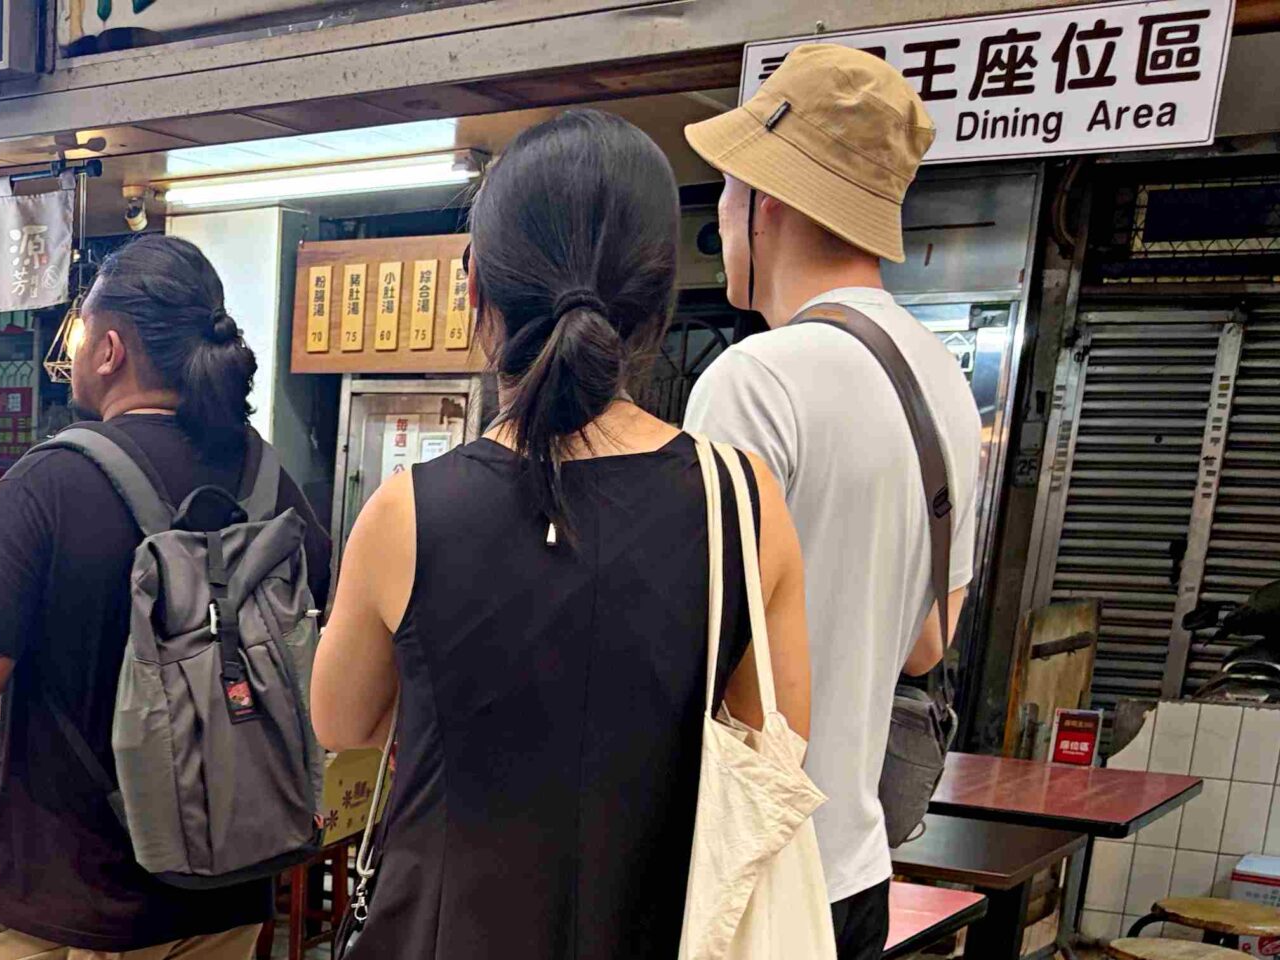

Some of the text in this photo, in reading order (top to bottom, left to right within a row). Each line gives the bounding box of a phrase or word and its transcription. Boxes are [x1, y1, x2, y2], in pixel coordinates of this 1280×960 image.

[759, 9, 1211, 101] 王座位區
[955, 100, 1177, 143] Dining Area
[345, 331, 357, 342] 75
[414, 329, 426, 341] 75
